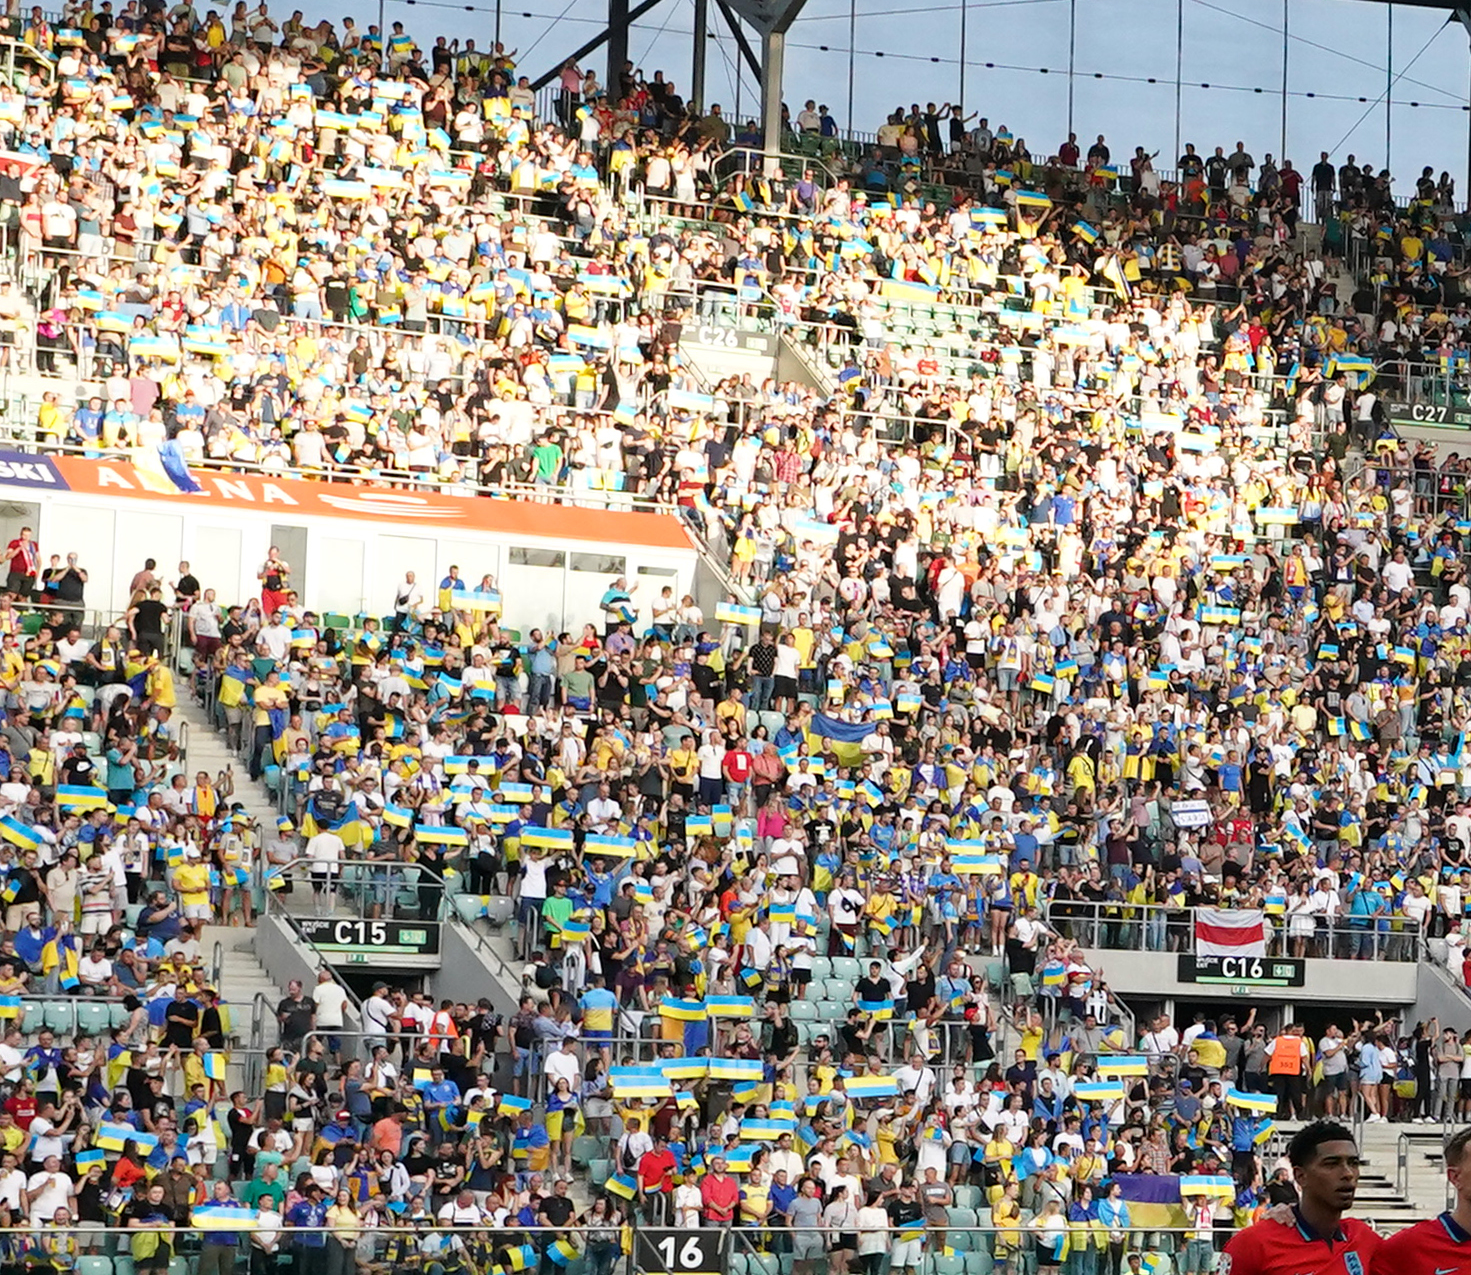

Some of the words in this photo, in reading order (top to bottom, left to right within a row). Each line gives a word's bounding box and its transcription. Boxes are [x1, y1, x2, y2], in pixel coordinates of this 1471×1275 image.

[699, 325, 738, 348] C26
[1412, 404, 1448, 423] C27
[334, 921, 387, 945] C15
[1222, 956, 1264, 978] C16
[658, 1236, 704, 1269] 16
